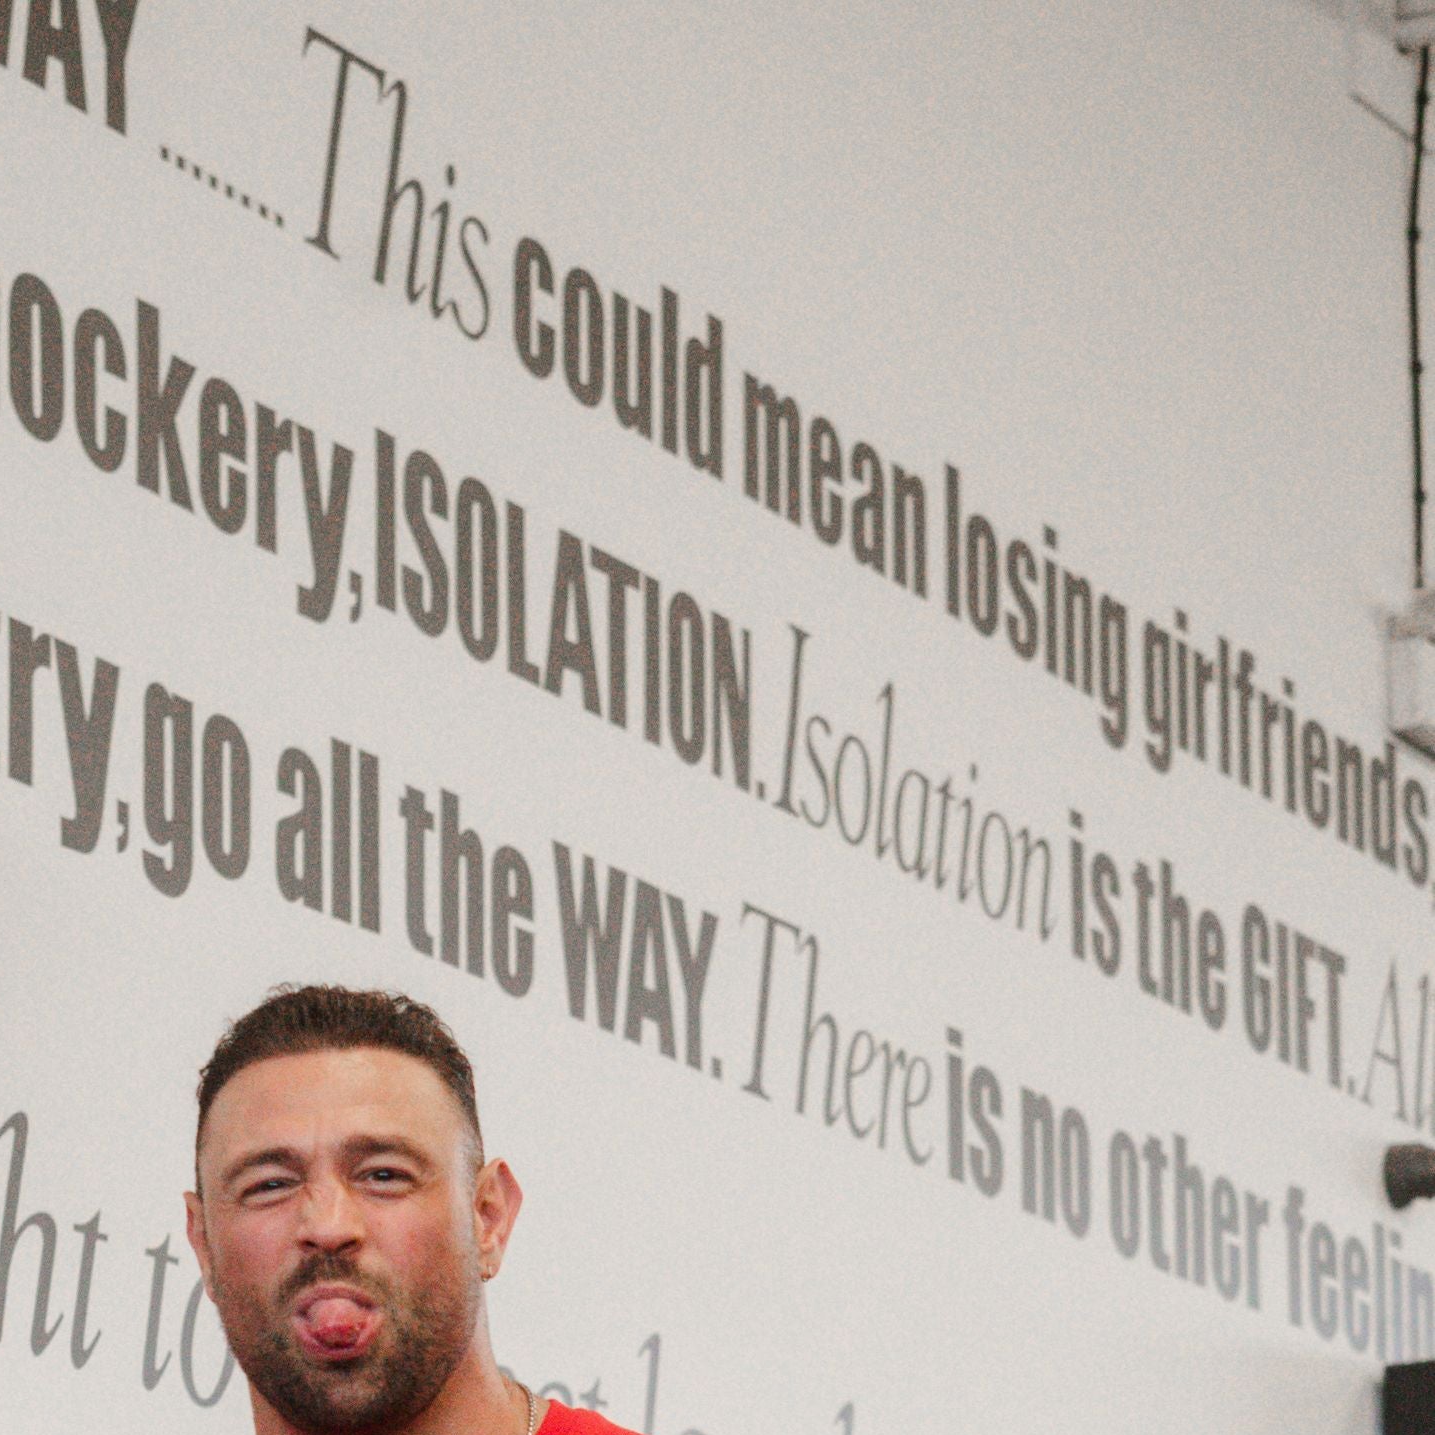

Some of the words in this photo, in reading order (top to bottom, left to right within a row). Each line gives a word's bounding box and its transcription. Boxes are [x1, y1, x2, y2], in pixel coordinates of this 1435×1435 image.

[302, 26, 491, 341] This
[512, 236, 724, 481] could
[743, 371, 928, 600] mean
[944, 462, 1129, 750] losing
[143, 682, 251, 898] go
[276, 737, 380, 934] all
[400, 784, 534, 998] the
[552, 840, 722, 1080] WAY.
[738, 902, 933, 1166] There
[946, 1026, 1004, 1199] is
[1020, 1086, 1091, 1240] no
[1109, 1130, 1269, 1311] other
[375, 428, 767, 801] ISOLATION.
[772, 623, 1054, 943] Isolation
[1069, 808, 1121, 978] is
[1132, 858, 1227, 1032] the
[1242, 903, 1355, 1097] GIFT.
